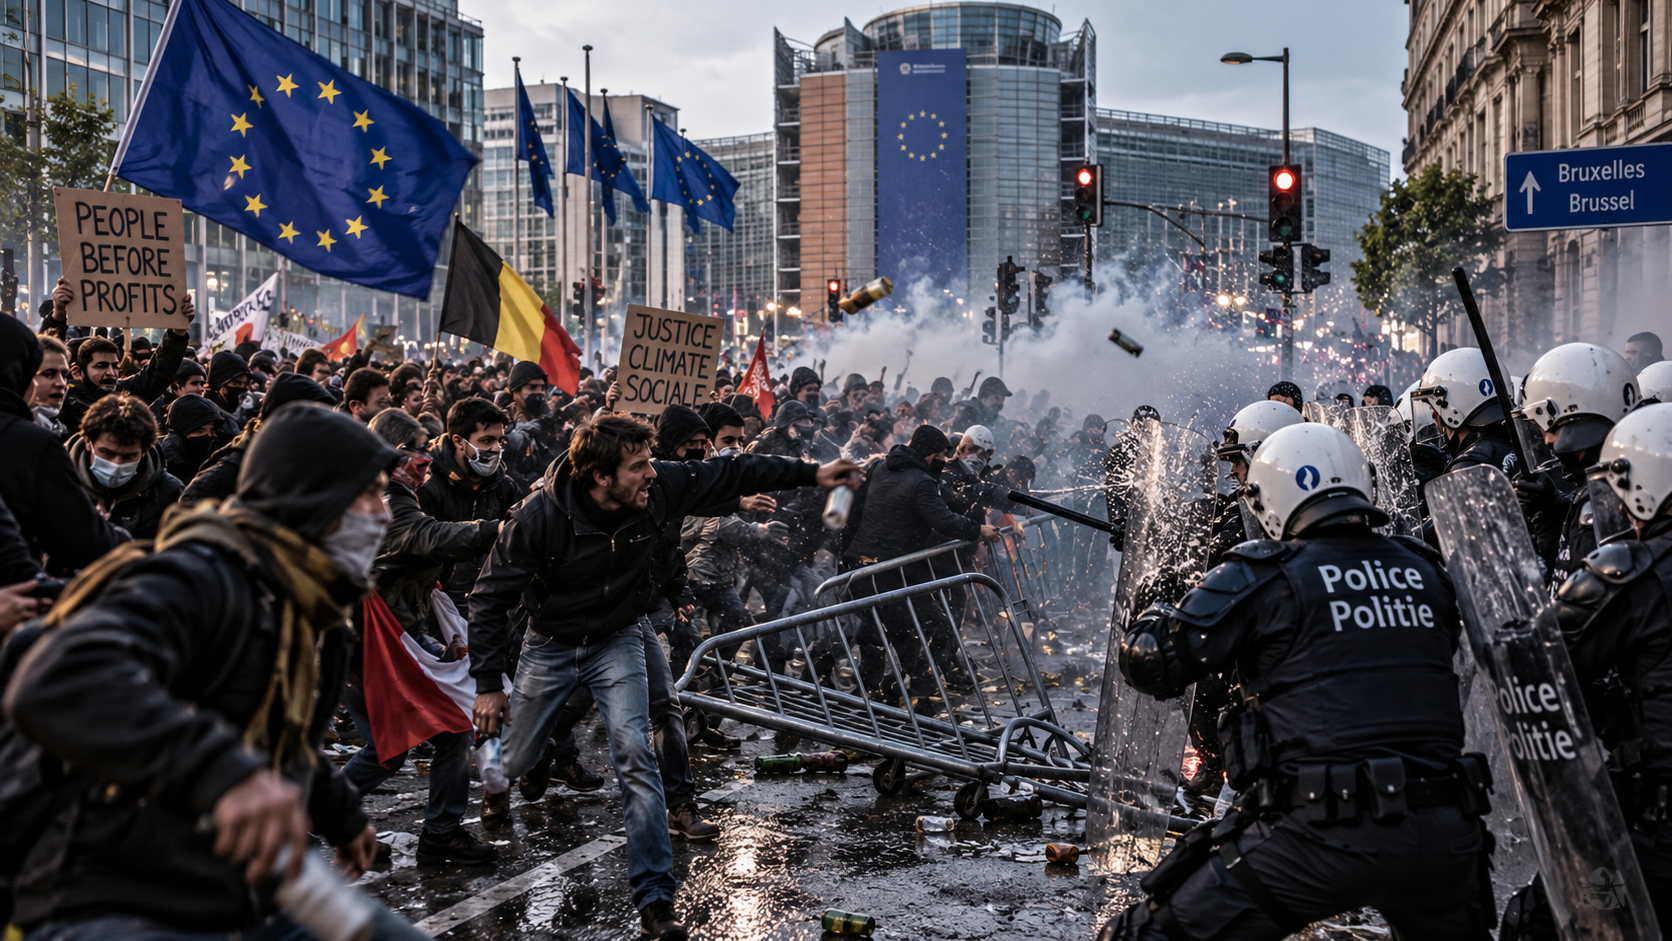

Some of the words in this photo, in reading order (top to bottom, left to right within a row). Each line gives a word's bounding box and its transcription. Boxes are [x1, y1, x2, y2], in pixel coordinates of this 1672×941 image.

[1559, 159, 1645, 183] Bruxelles
[1570, 190, 1634, 213] Brussel
[75, 201, 169, 241] PEOPLE
[80, 242, 172, 277] BEFORE
[81, 279, 177, 315] PROFITS
[633, 313, 716, 349] JUSTICE
[629, 344, 711, 379] CLIMATE
[624, 374, 707, 408] SOCIALE
[1318, 560, 1424, 593] Police
[1329, 595, 1434, 632] Politie
